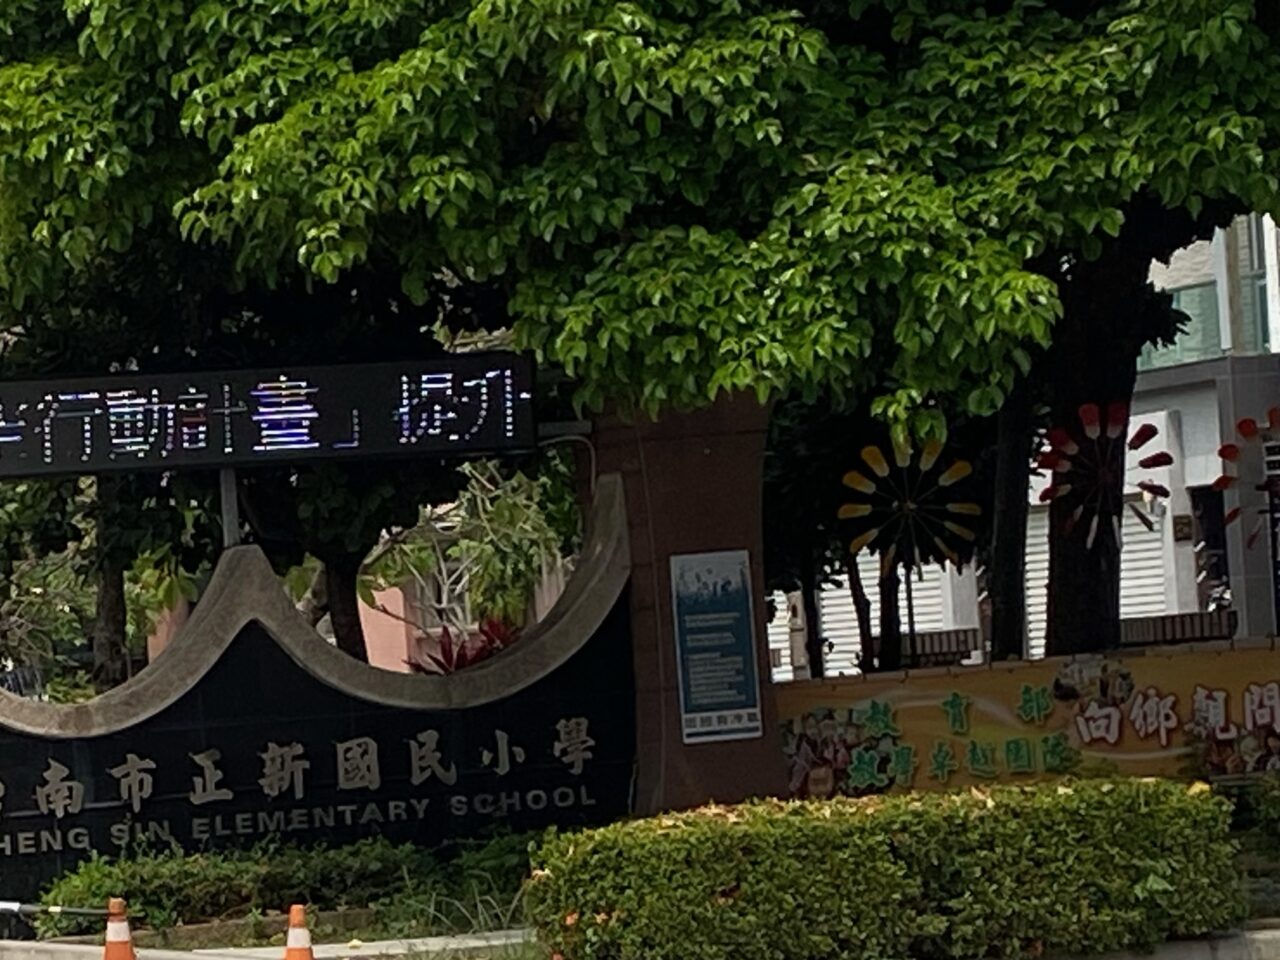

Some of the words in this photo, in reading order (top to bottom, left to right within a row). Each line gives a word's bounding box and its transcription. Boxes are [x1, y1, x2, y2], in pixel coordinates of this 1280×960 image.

[110, 820, 172, 845] SIN
[192, 796, 428, 838] ELEMENTARY
[452, 786, 596, 816] SCHOOL
